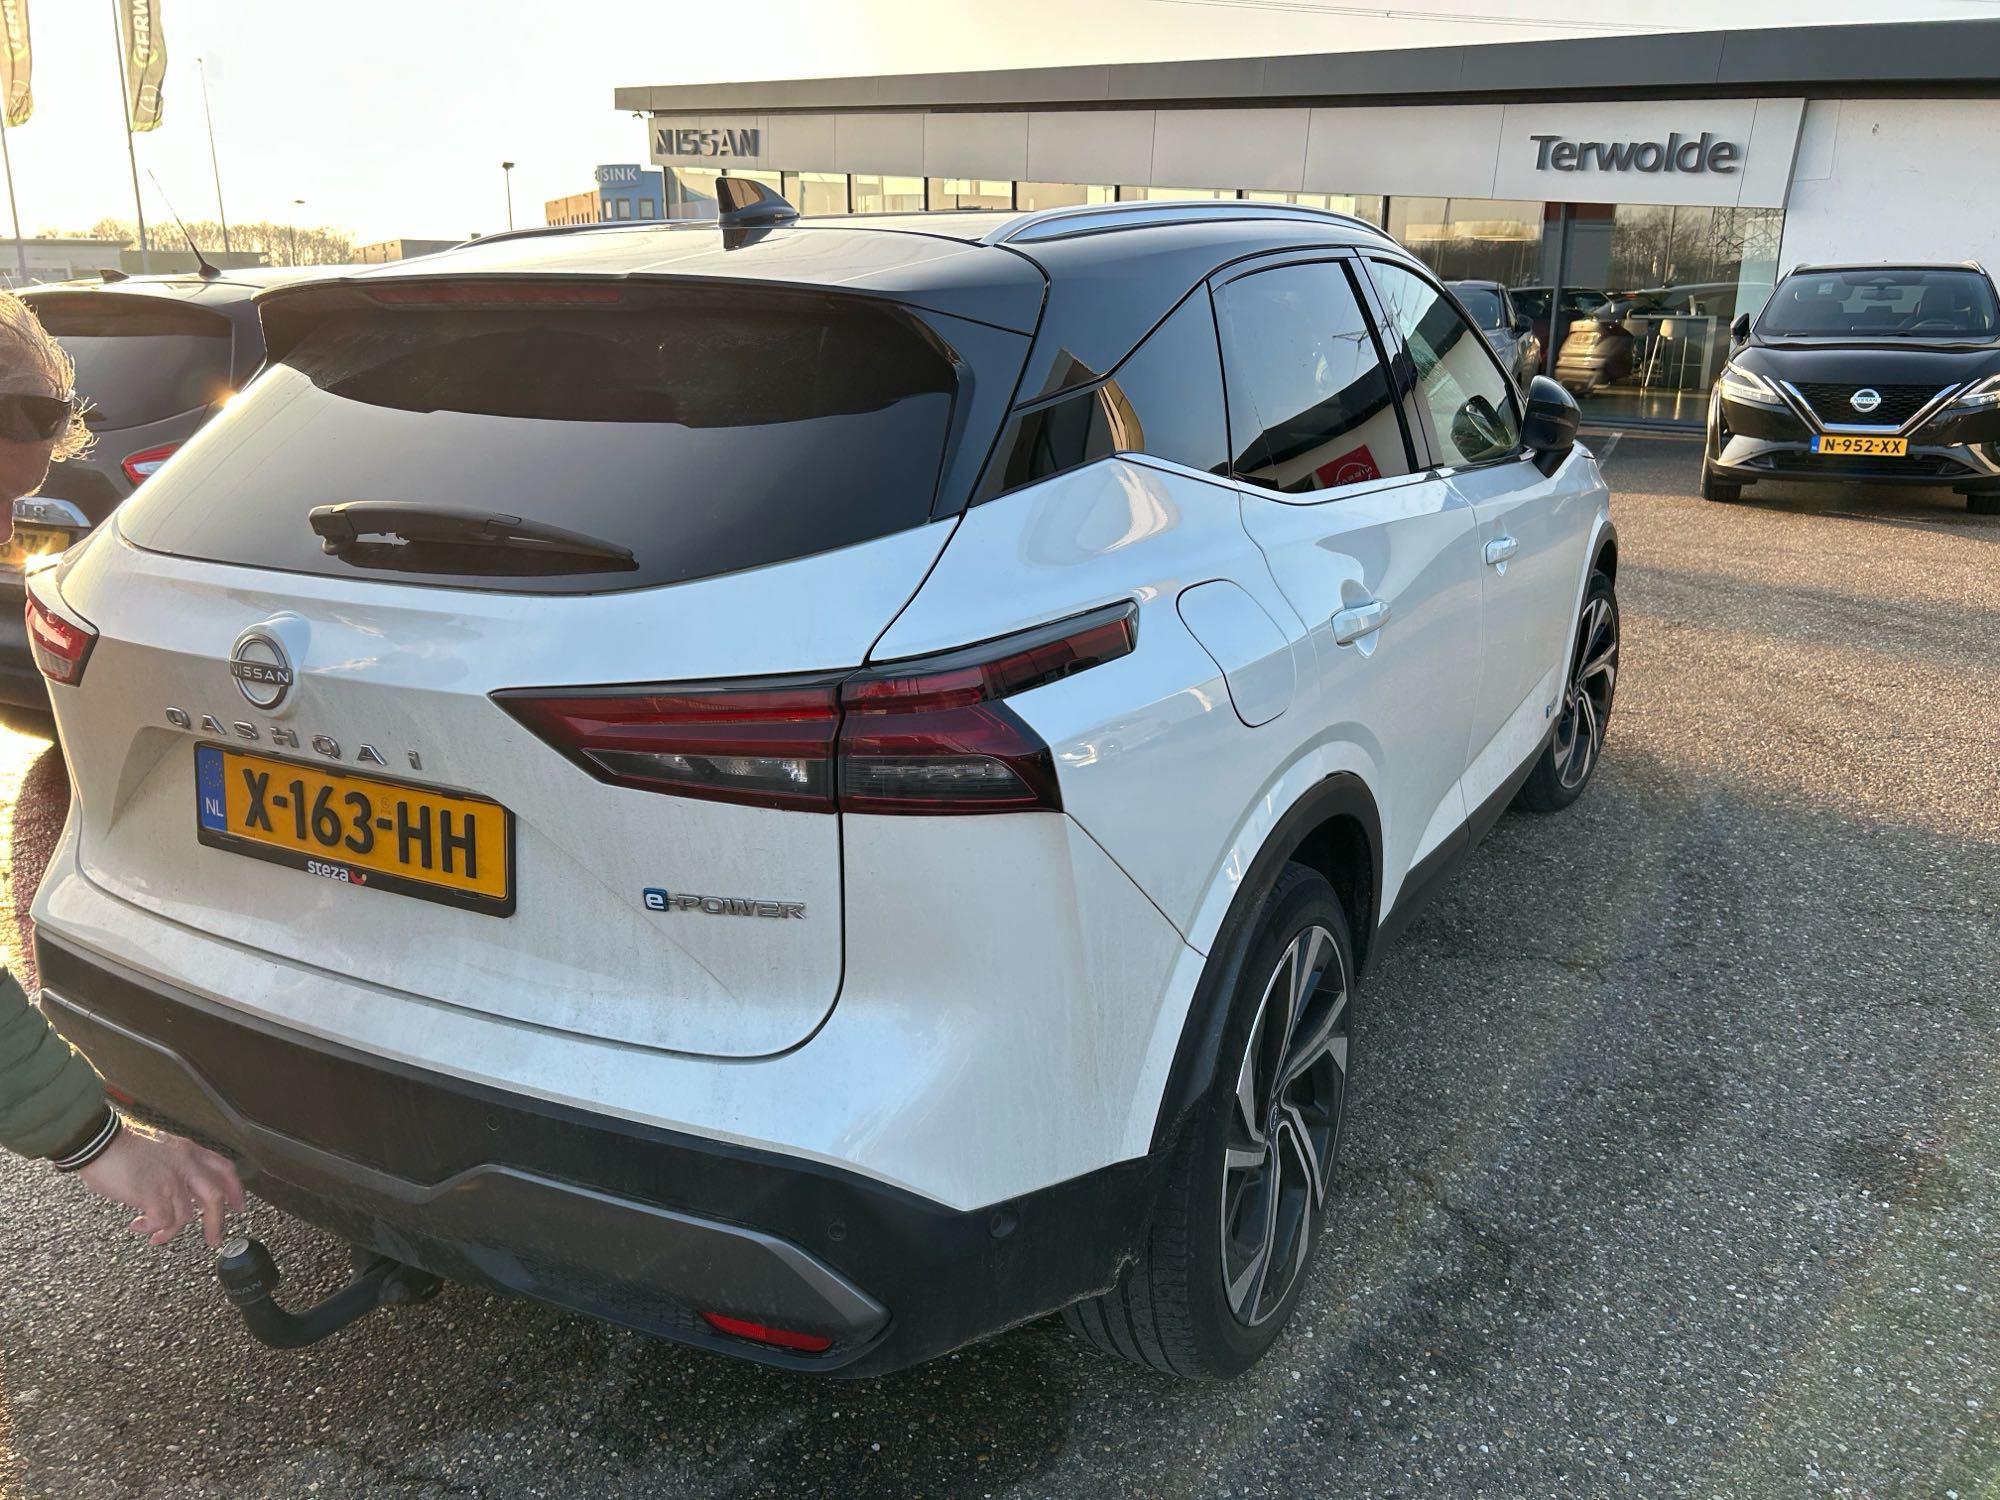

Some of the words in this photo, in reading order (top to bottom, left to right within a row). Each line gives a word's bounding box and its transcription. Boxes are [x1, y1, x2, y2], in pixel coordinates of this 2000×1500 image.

[656, 129, 759, 157] NISSAN
[1530, 132, 1738, 174] Terwolde
[1824, 439, 1902, 453] N-952-XX
[231, 662, 290, 684] NISSAN
[205, 798, 224, 818] NL
[242, 768, 477, 879] X-163-HH
[307, 860, 349, 883] steza
